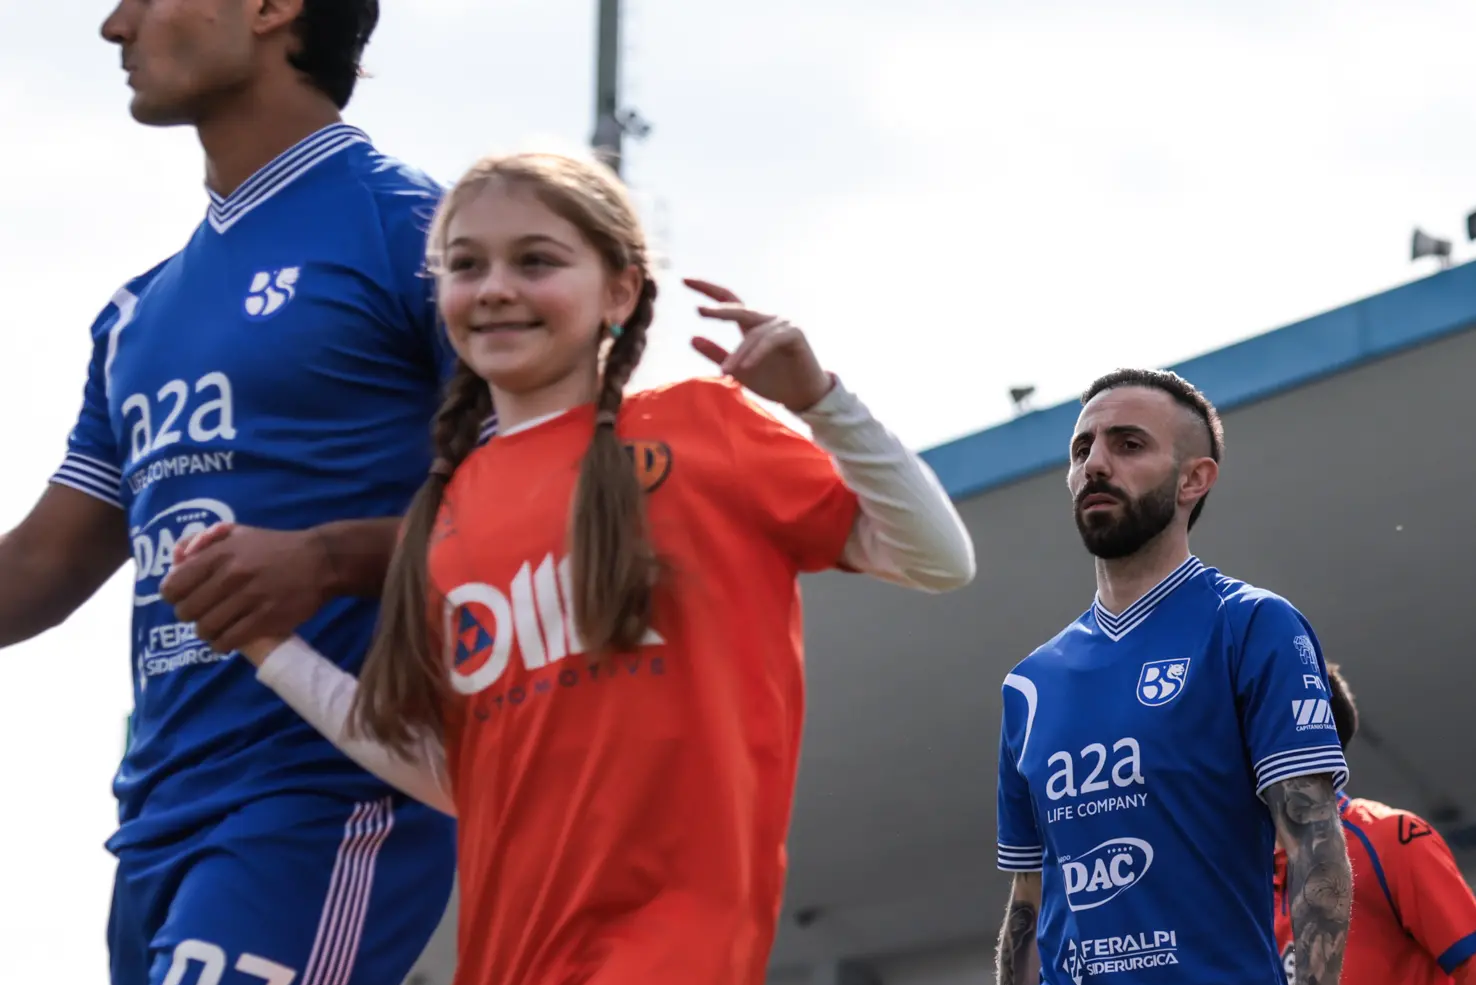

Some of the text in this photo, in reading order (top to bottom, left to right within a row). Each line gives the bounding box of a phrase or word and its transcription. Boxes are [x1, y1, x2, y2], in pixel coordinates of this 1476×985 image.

[121, 371, 238, 464] a2a
[1045, 737, 1145, 800] a2a
[1047, 793, 1148, 823] LIFE COMPANY
[1062, 853, 1135, 895] DAC
[1081, 930, 1177, 958] FERALPI
[1086, 952, 1179, 976] SIDERURGICA
